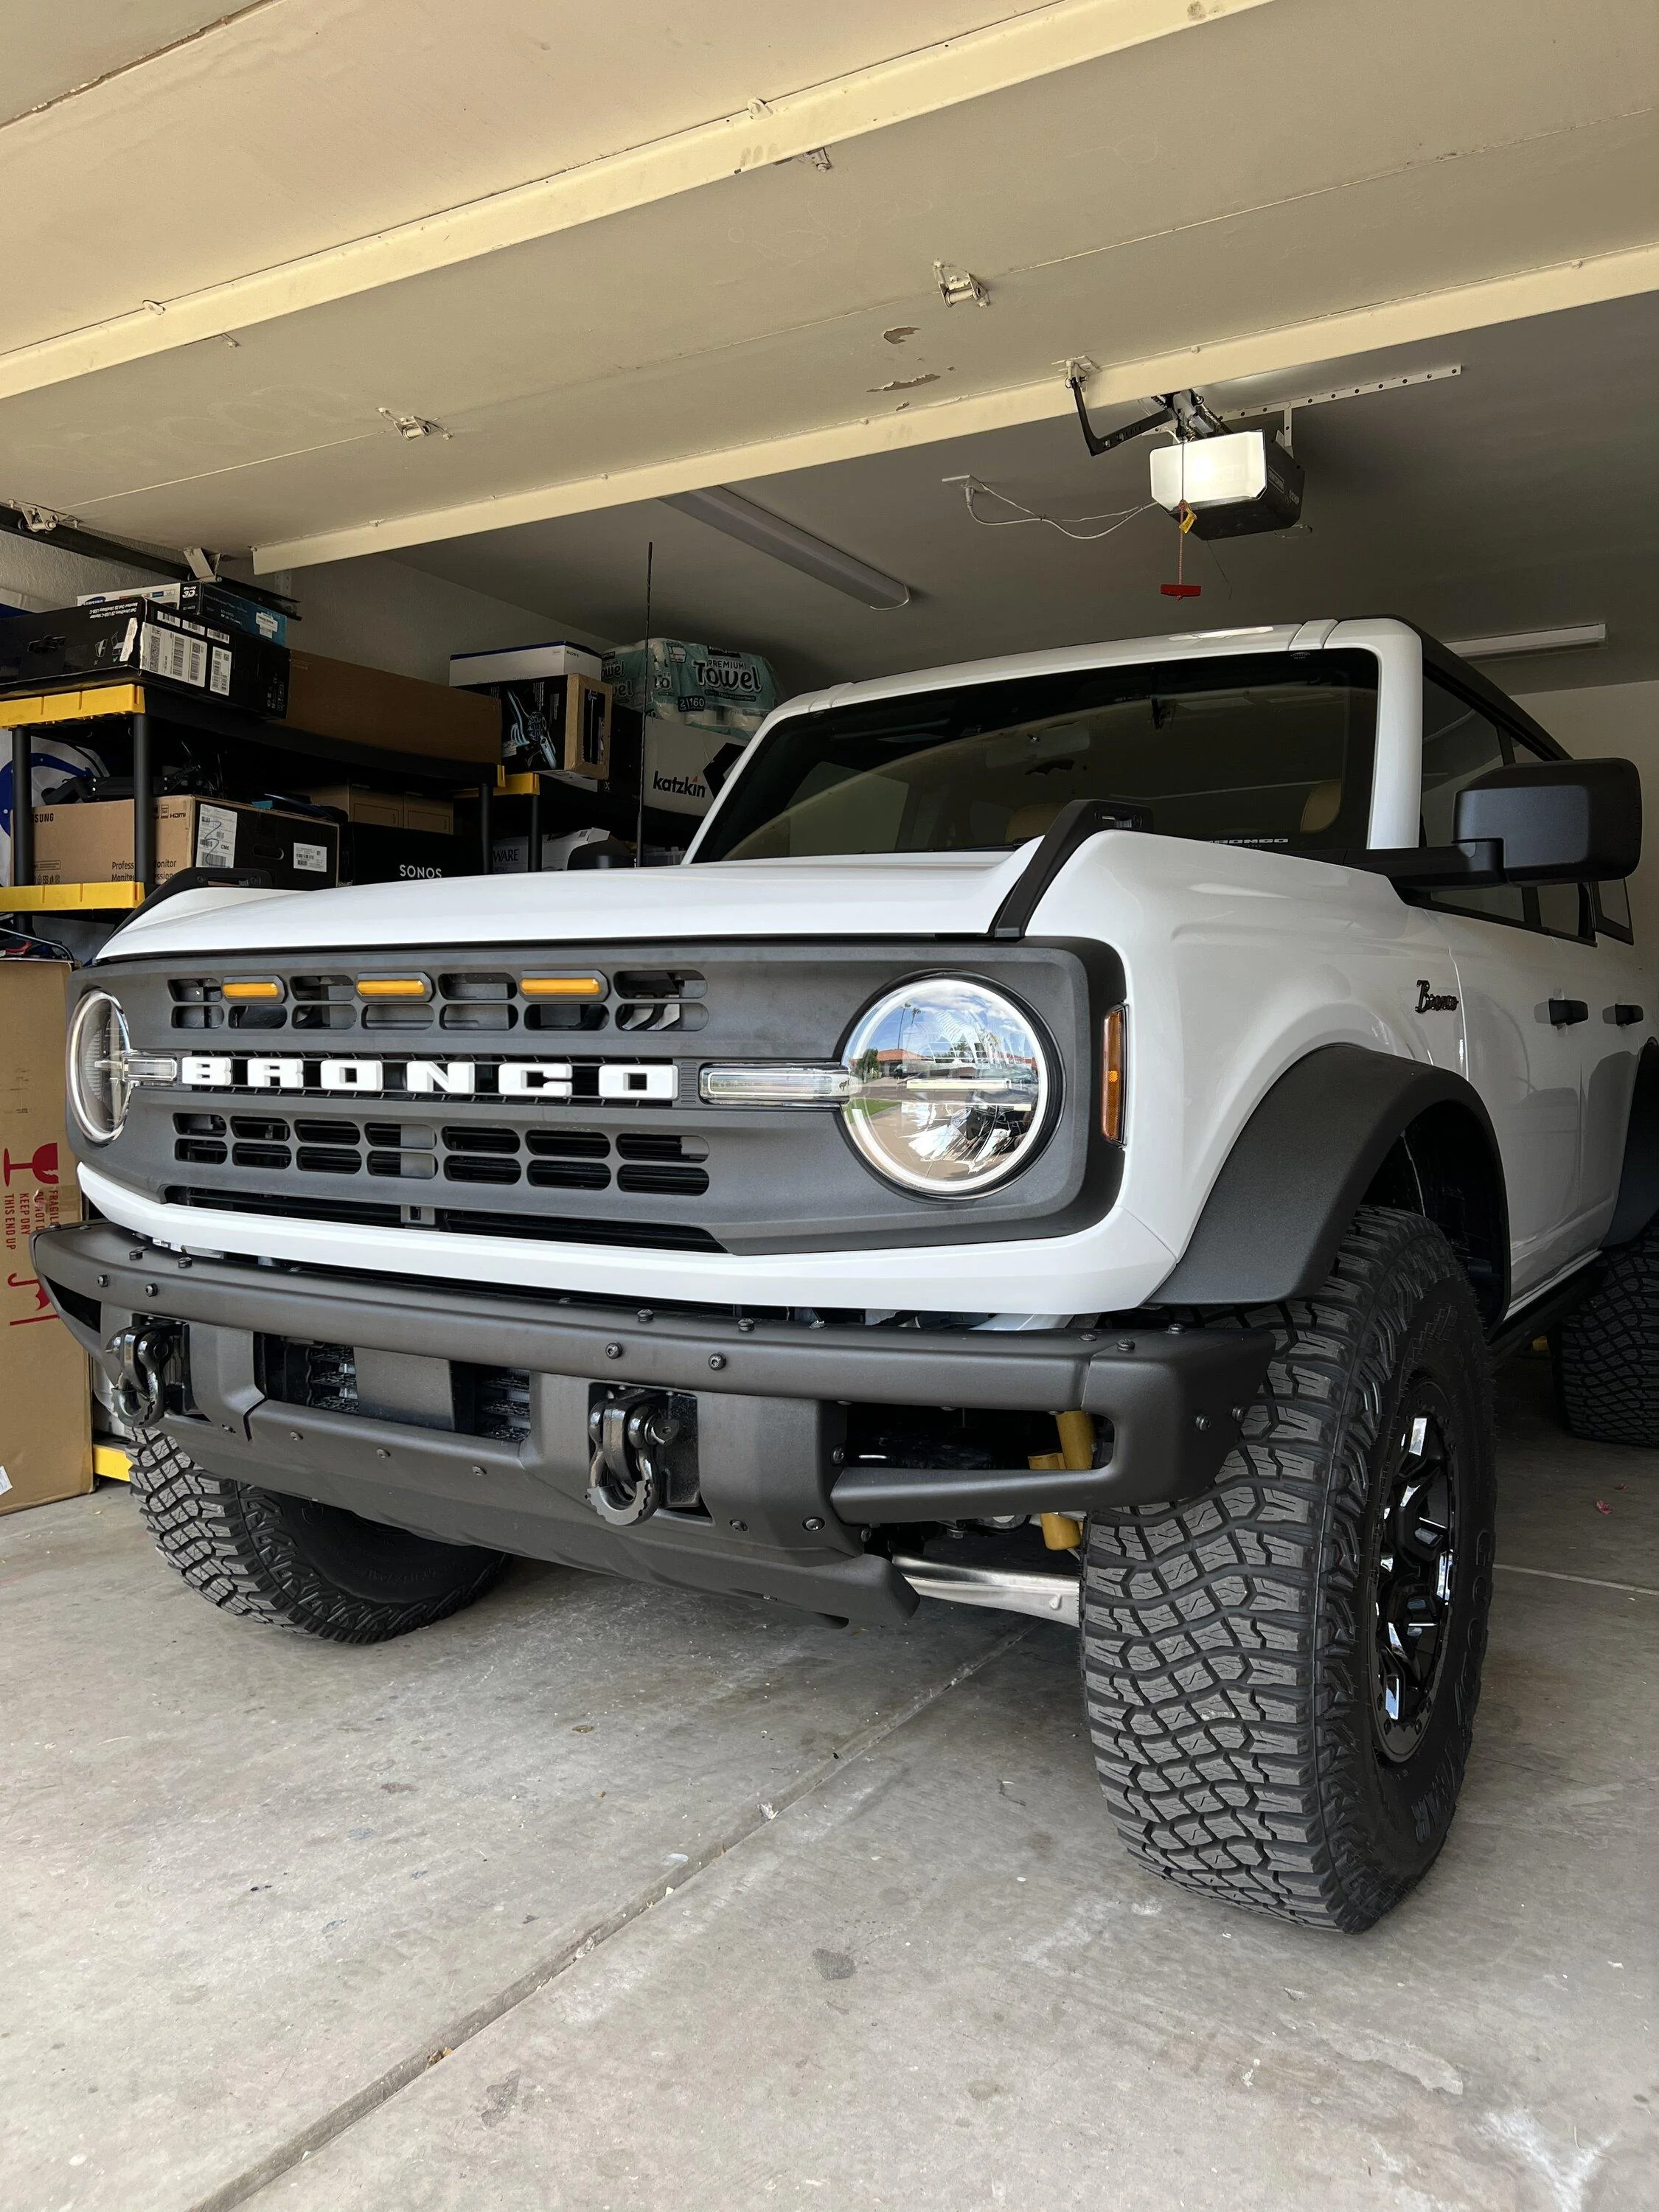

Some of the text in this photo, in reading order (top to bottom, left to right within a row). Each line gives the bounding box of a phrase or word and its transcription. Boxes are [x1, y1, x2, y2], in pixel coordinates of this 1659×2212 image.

[601, 661, 625, 678] owel
[692, 661, 762, 692] Towel
[709, 660, 744, 669] PREMIUM
[689, 698, 705, 707] 160
[653, 771, 706, 798] katzkin
[153, 859, 177, 869] onitor
[400, 864, 442, 879] SONOS
[1415, 979, 1460, 1014] Bronco
[181, 1056, 678, 1099] BRONCO
[4, 1194, 16, 1250] THIS END UP
[20, 1193, 31, 1235] KEEP DRY
